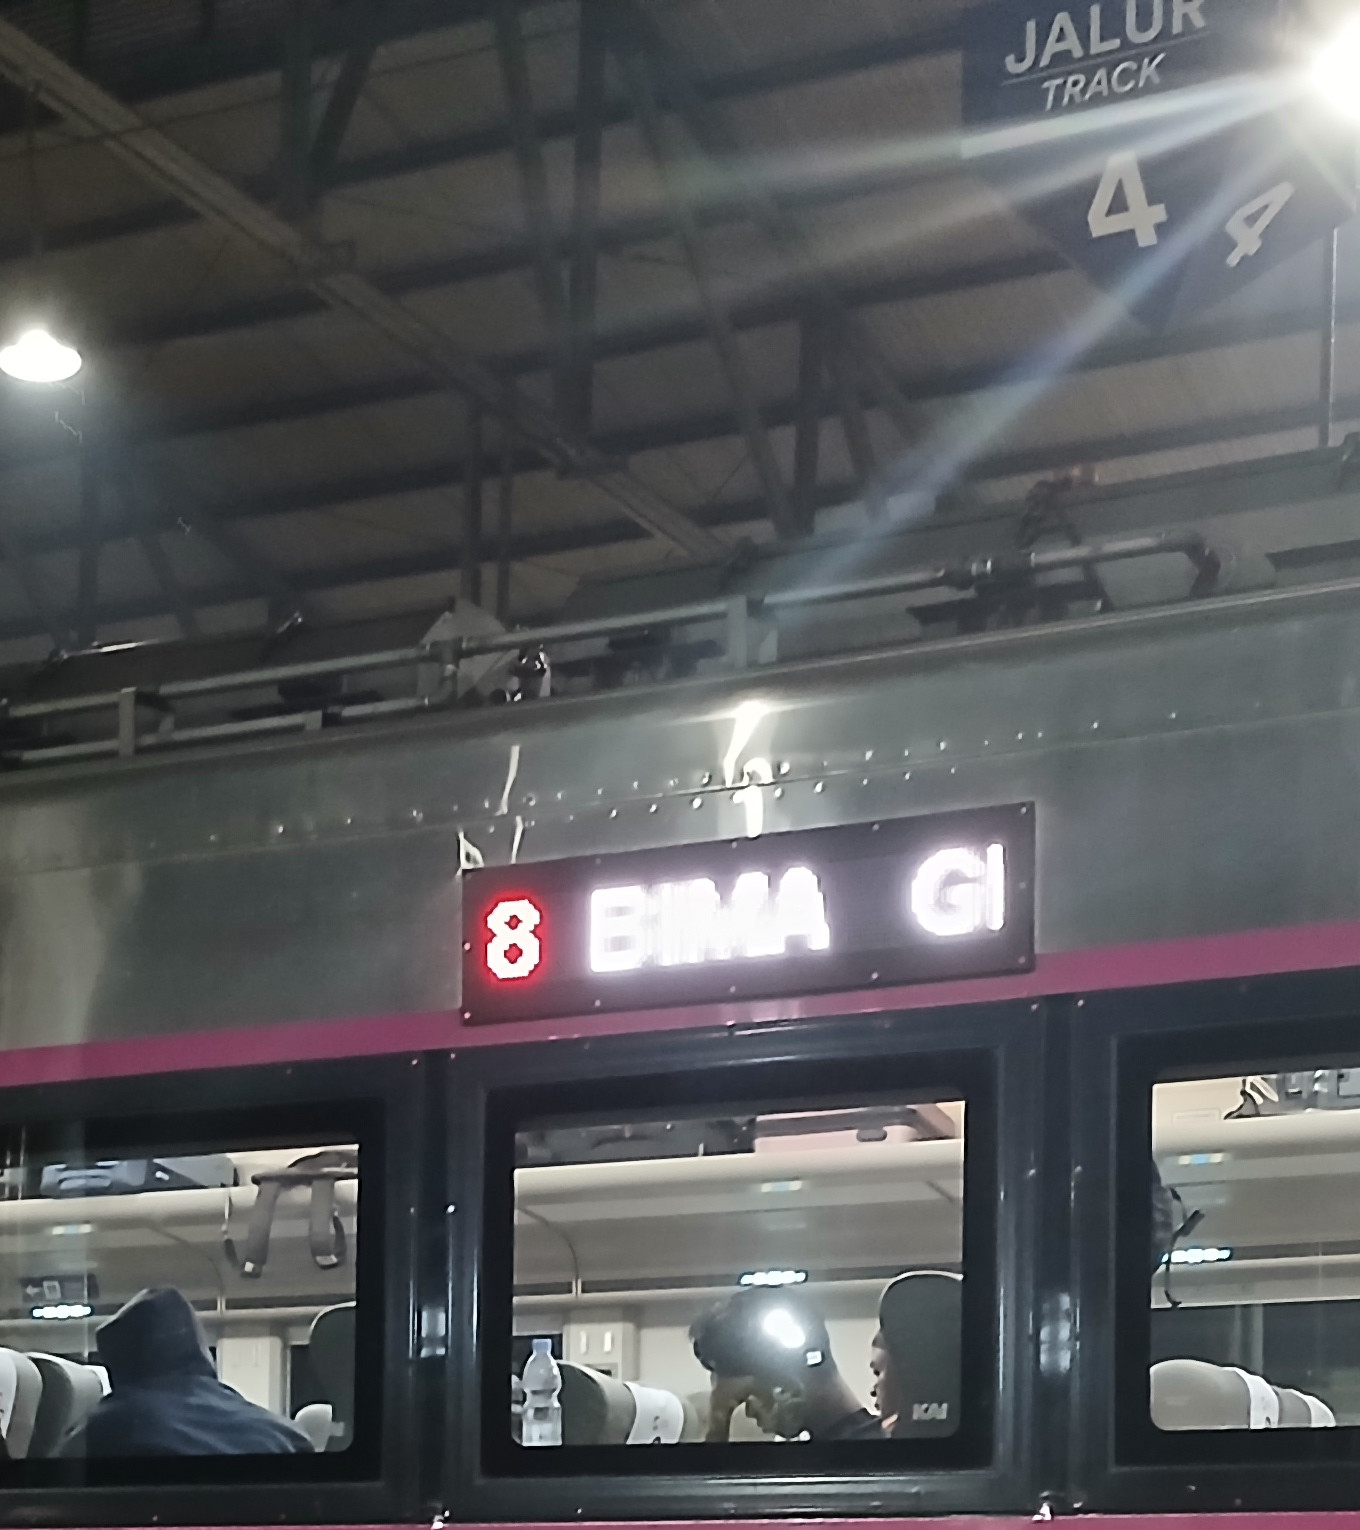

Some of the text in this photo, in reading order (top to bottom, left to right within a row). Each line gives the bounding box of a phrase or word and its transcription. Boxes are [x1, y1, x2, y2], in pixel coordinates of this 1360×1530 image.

[1004, 0, 1207, 75] JALUR
[1042, 53, 1166, 111] TRACK
[1087, 151, 1168, 247] 4
[1225, 181, 1295, 268] 4
[486, 899, 541, 980] 8
[590, 866, 830, 973] BIMA
